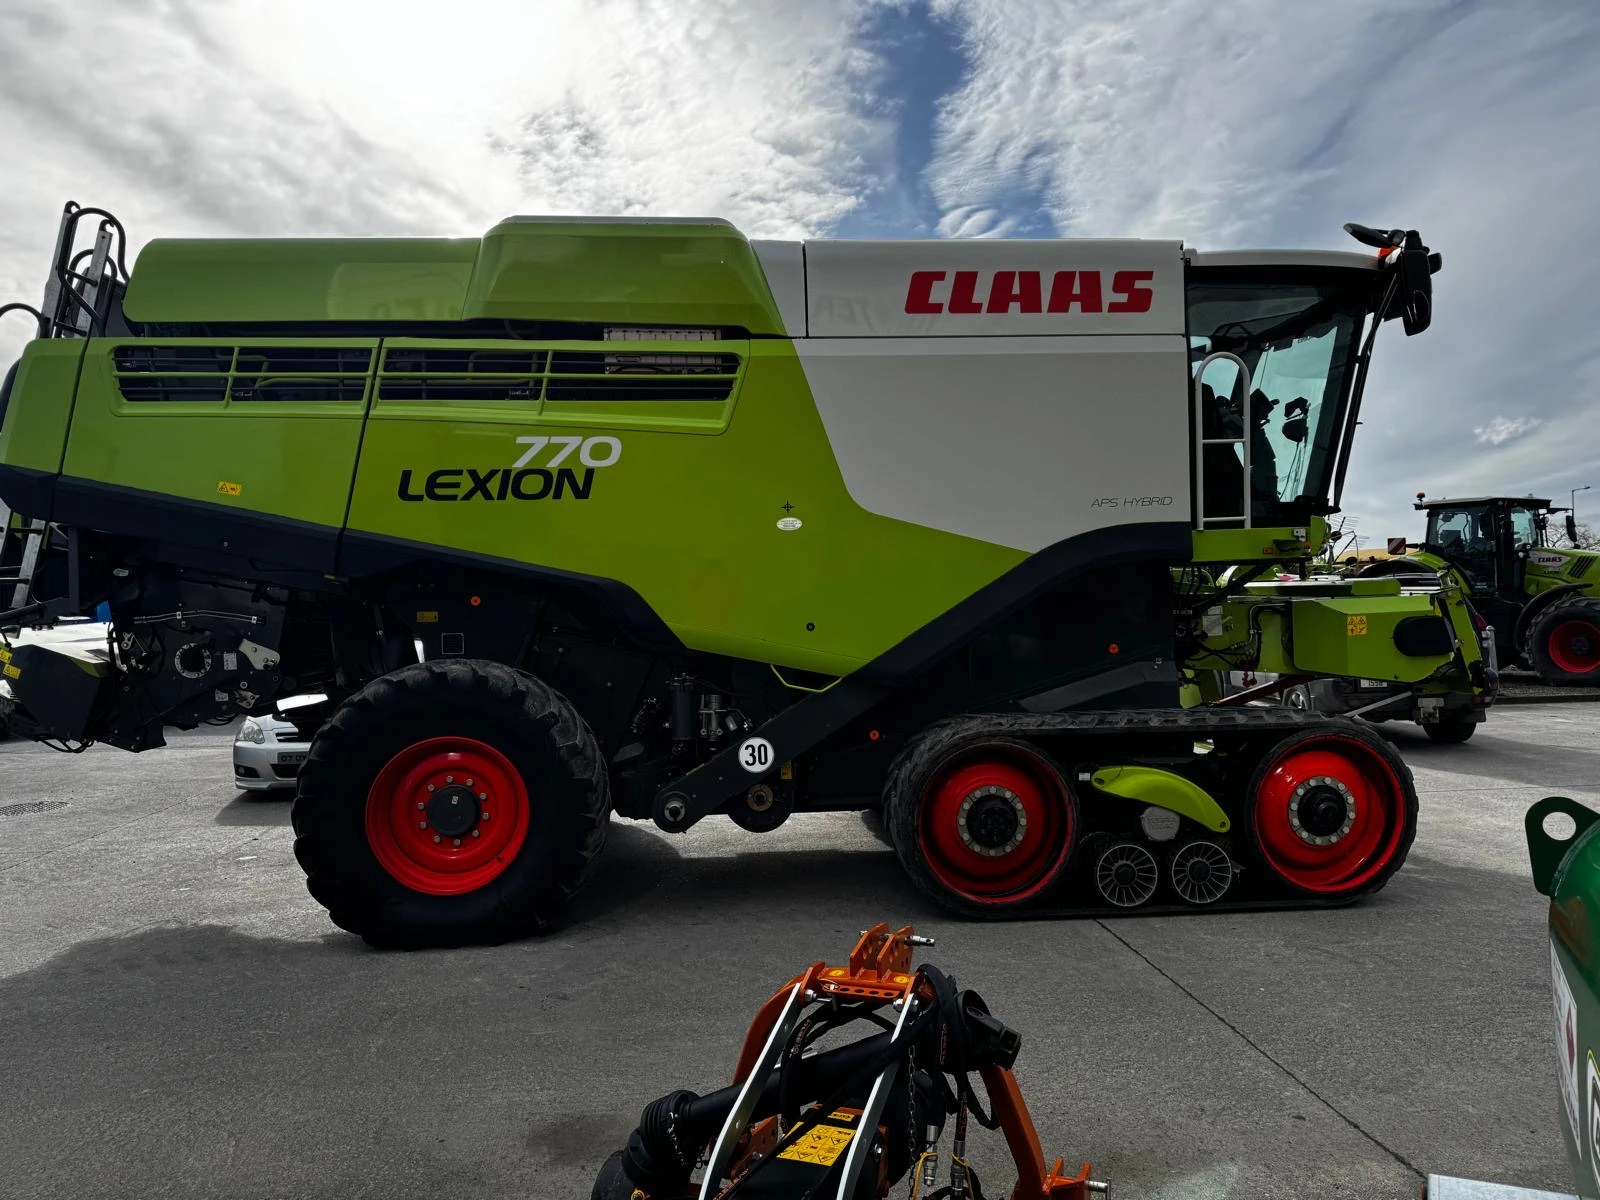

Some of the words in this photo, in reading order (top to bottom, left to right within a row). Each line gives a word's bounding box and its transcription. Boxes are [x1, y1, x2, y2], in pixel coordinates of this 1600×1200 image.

[904, 270, 1154, 314] CLAAS
[512, 436, 622, 467] 770
[397, 468, 595, 501] LEXION
[1090, 498, 1120, 508] APS
[1123, 496, 1173, 507] HYBRID
[744, 743, 768, 767] 30
